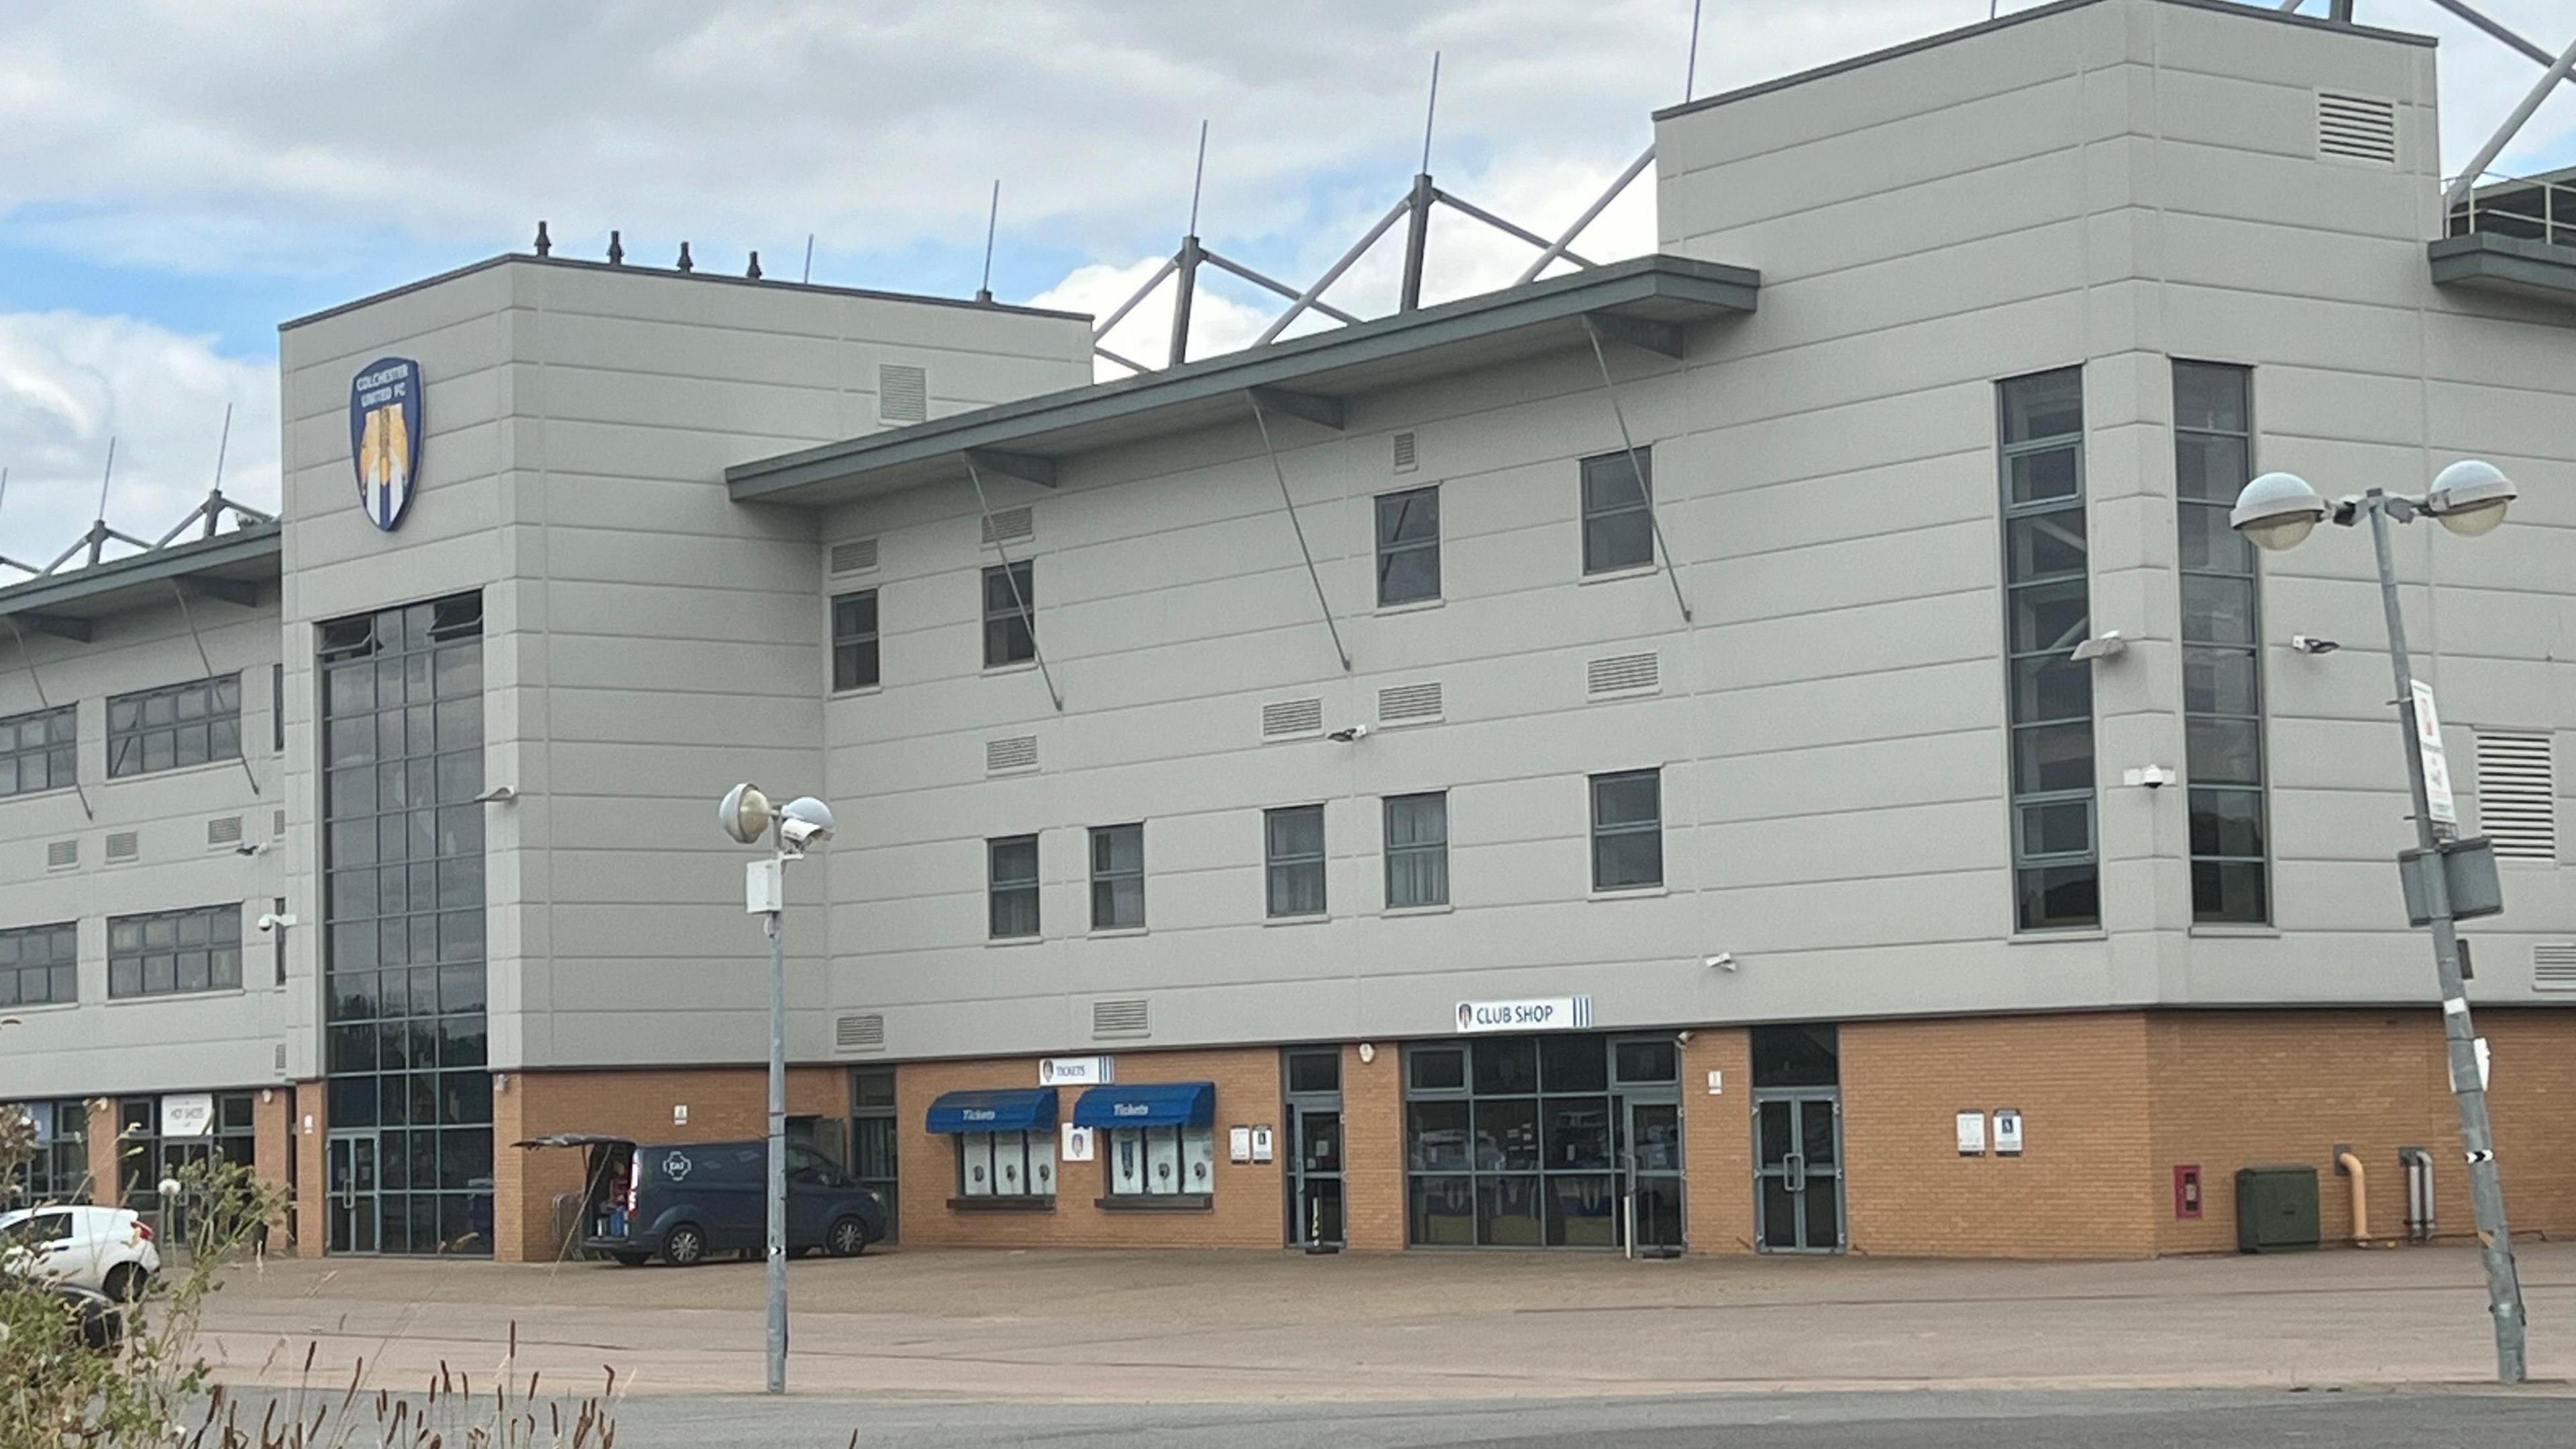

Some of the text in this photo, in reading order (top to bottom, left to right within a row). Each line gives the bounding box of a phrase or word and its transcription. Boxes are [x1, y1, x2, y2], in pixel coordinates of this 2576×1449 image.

[356, 364, 408, 391] COLCHESTER
[361, 382, 406, 407] UNITED FC
[1477, 1005, 1554, 1024] CLUB SHOP
[1056, 1065, 1085, 1077] TICKETS
[963, 1110, 996, 1121] Tickets
[1114, 1104, 1148, 1116] Tickets
